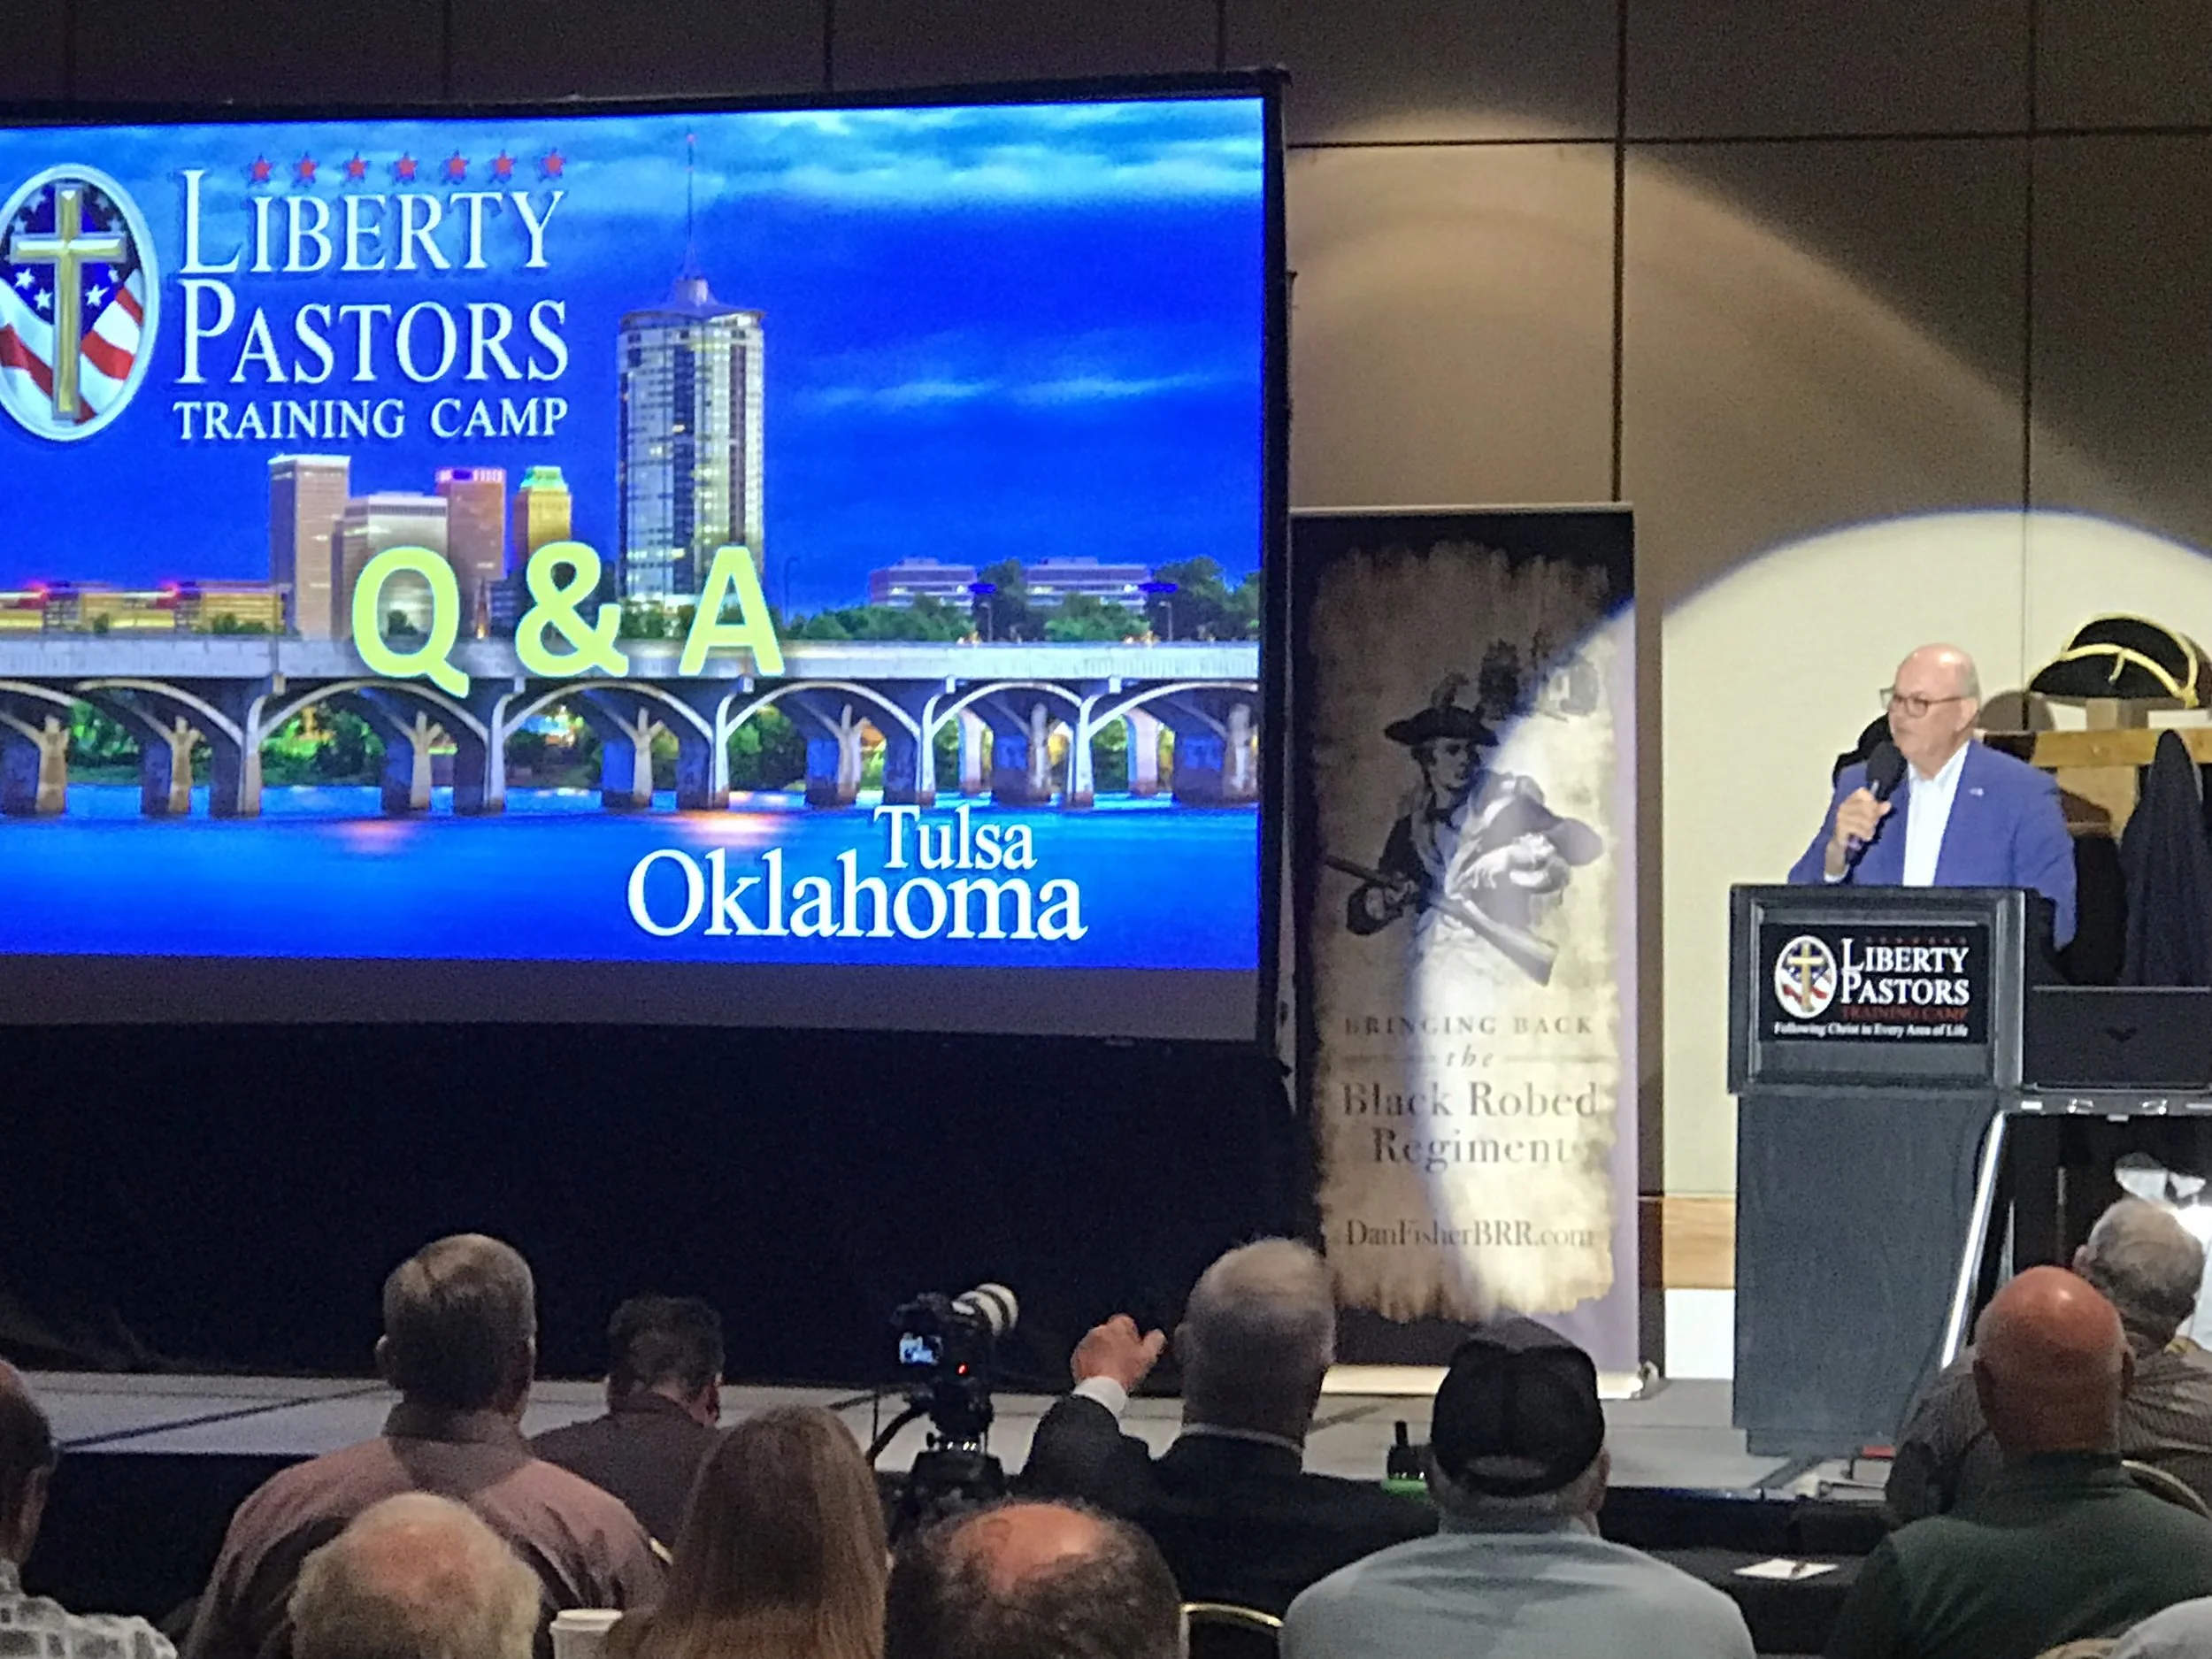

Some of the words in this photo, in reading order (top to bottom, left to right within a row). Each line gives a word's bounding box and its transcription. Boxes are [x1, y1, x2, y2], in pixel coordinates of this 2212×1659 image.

[179, 169, 565, 274] LIBERTY
[173, 279, 569, 384] PASTORS
[173, 398, 406, 440] TRAINING
[430, 396, 569, 438] CAMP
[352, 546, 470, 698] Q
[515, 541, 629, 678] &
[679, 546, 786, 676] A
[873, 803, 1038, 870] Tulsa
[627, 847, 1088, 941] Oklahoma
[1840, 937, 1970, 973] LIBERTY
[1840, 972, 1970, 1006] PASTORS
[1345, 1016, 1497, 1036] BRINGING
[1513, 1016, 1594, 1035] BACK
[1446, 1044, 1494, 1068] the
[1341, 1081, 1455, 1118] Black
[1469, 1080, 1598, 1118] Robed
[1371, 1127, 1568, 1174] Regiment
[1346, 1218, 1595, 1248] DanFisherBRR.com
